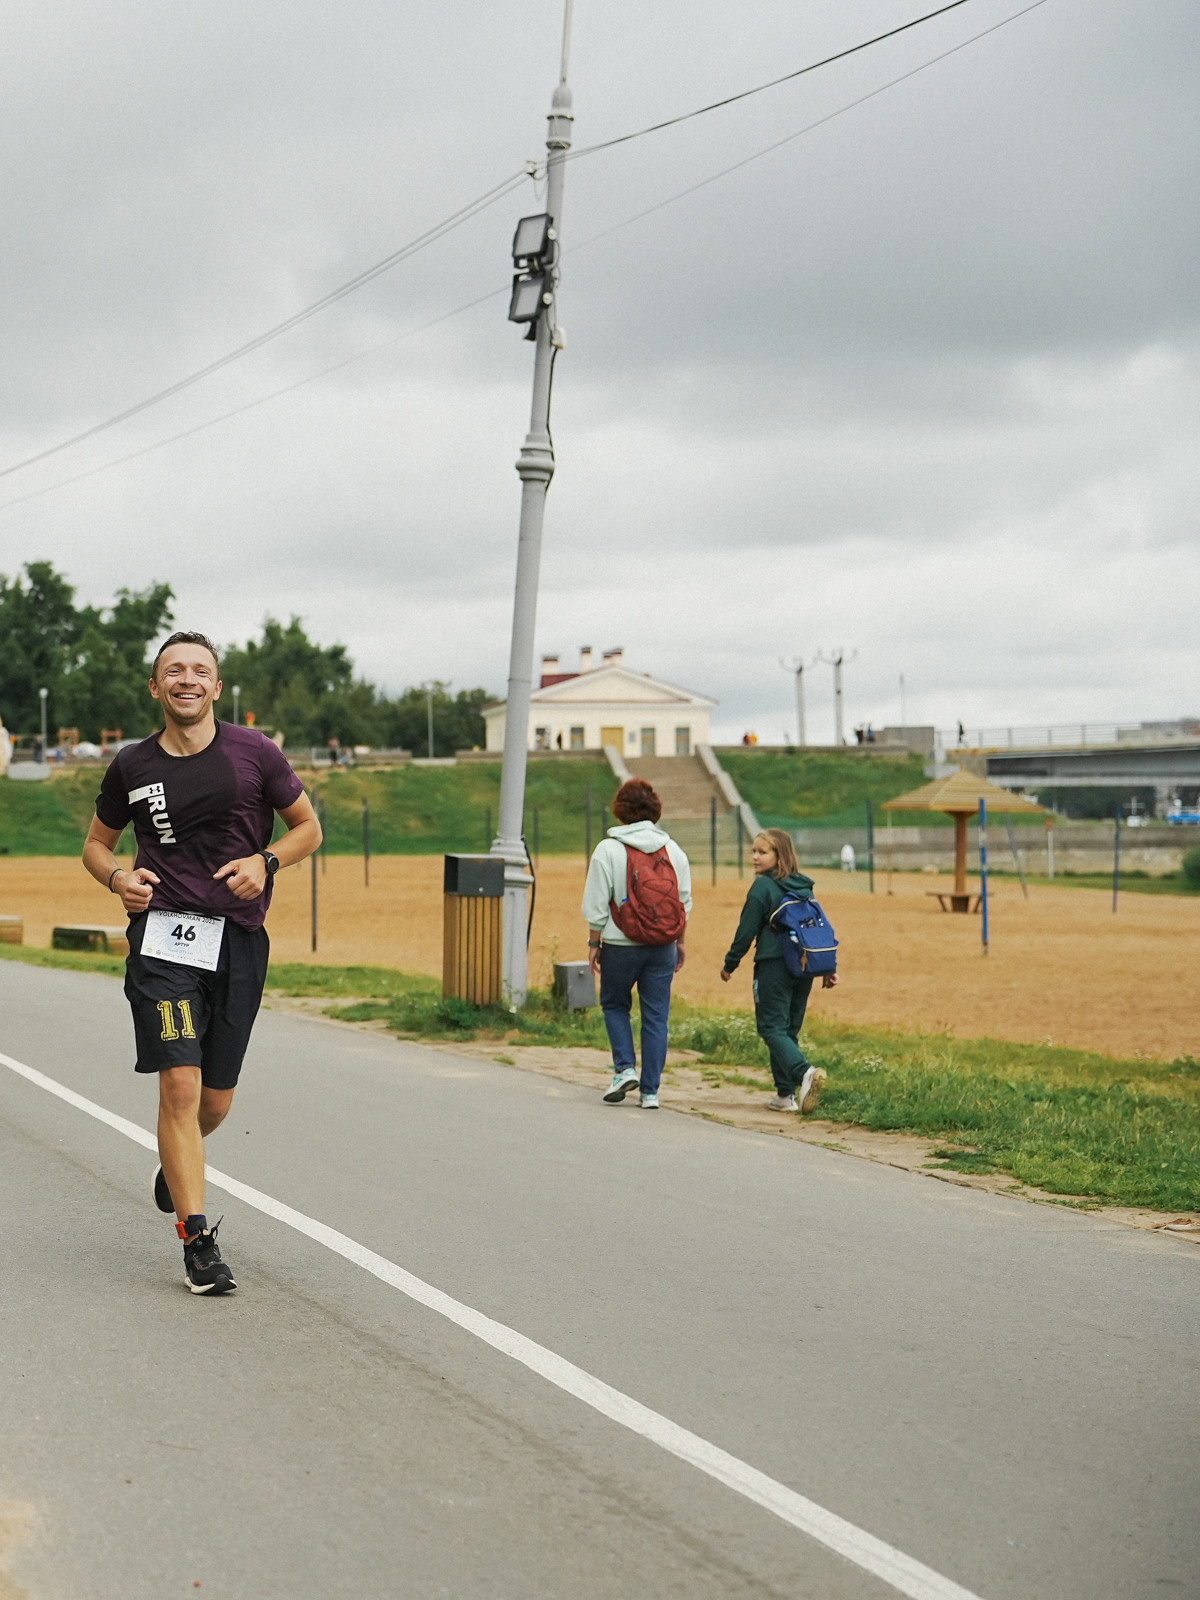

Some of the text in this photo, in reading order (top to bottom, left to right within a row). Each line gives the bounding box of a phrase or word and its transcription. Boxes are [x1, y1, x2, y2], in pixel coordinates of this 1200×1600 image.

[148, 795, 176, 843] RUN
[171, 924, 196, 941] 46
[157, 999, 196, 1041] 11
